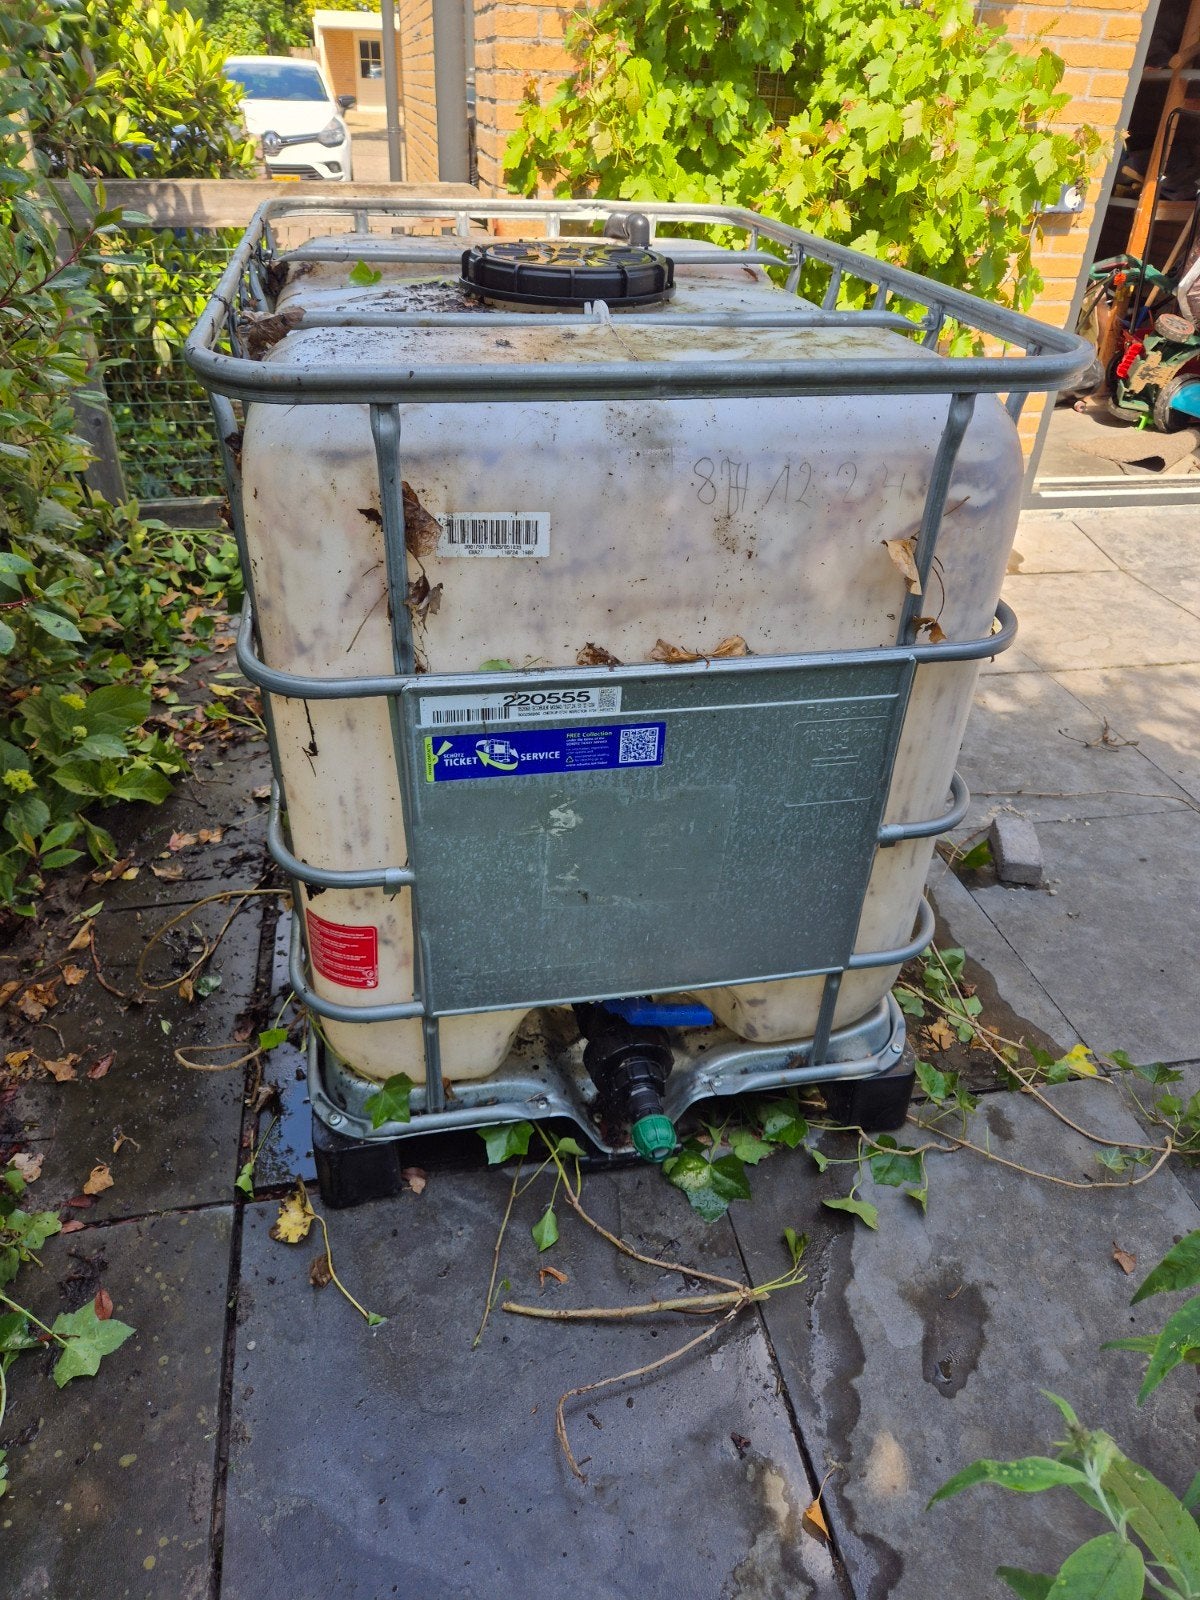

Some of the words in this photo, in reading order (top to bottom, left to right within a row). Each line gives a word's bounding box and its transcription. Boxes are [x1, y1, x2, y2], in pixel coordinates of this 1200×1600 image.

[503, 691, 591, 707] 220555
[443, 756, 479, 767] TICKET
[520, 750, 561, 761] SERVICE
